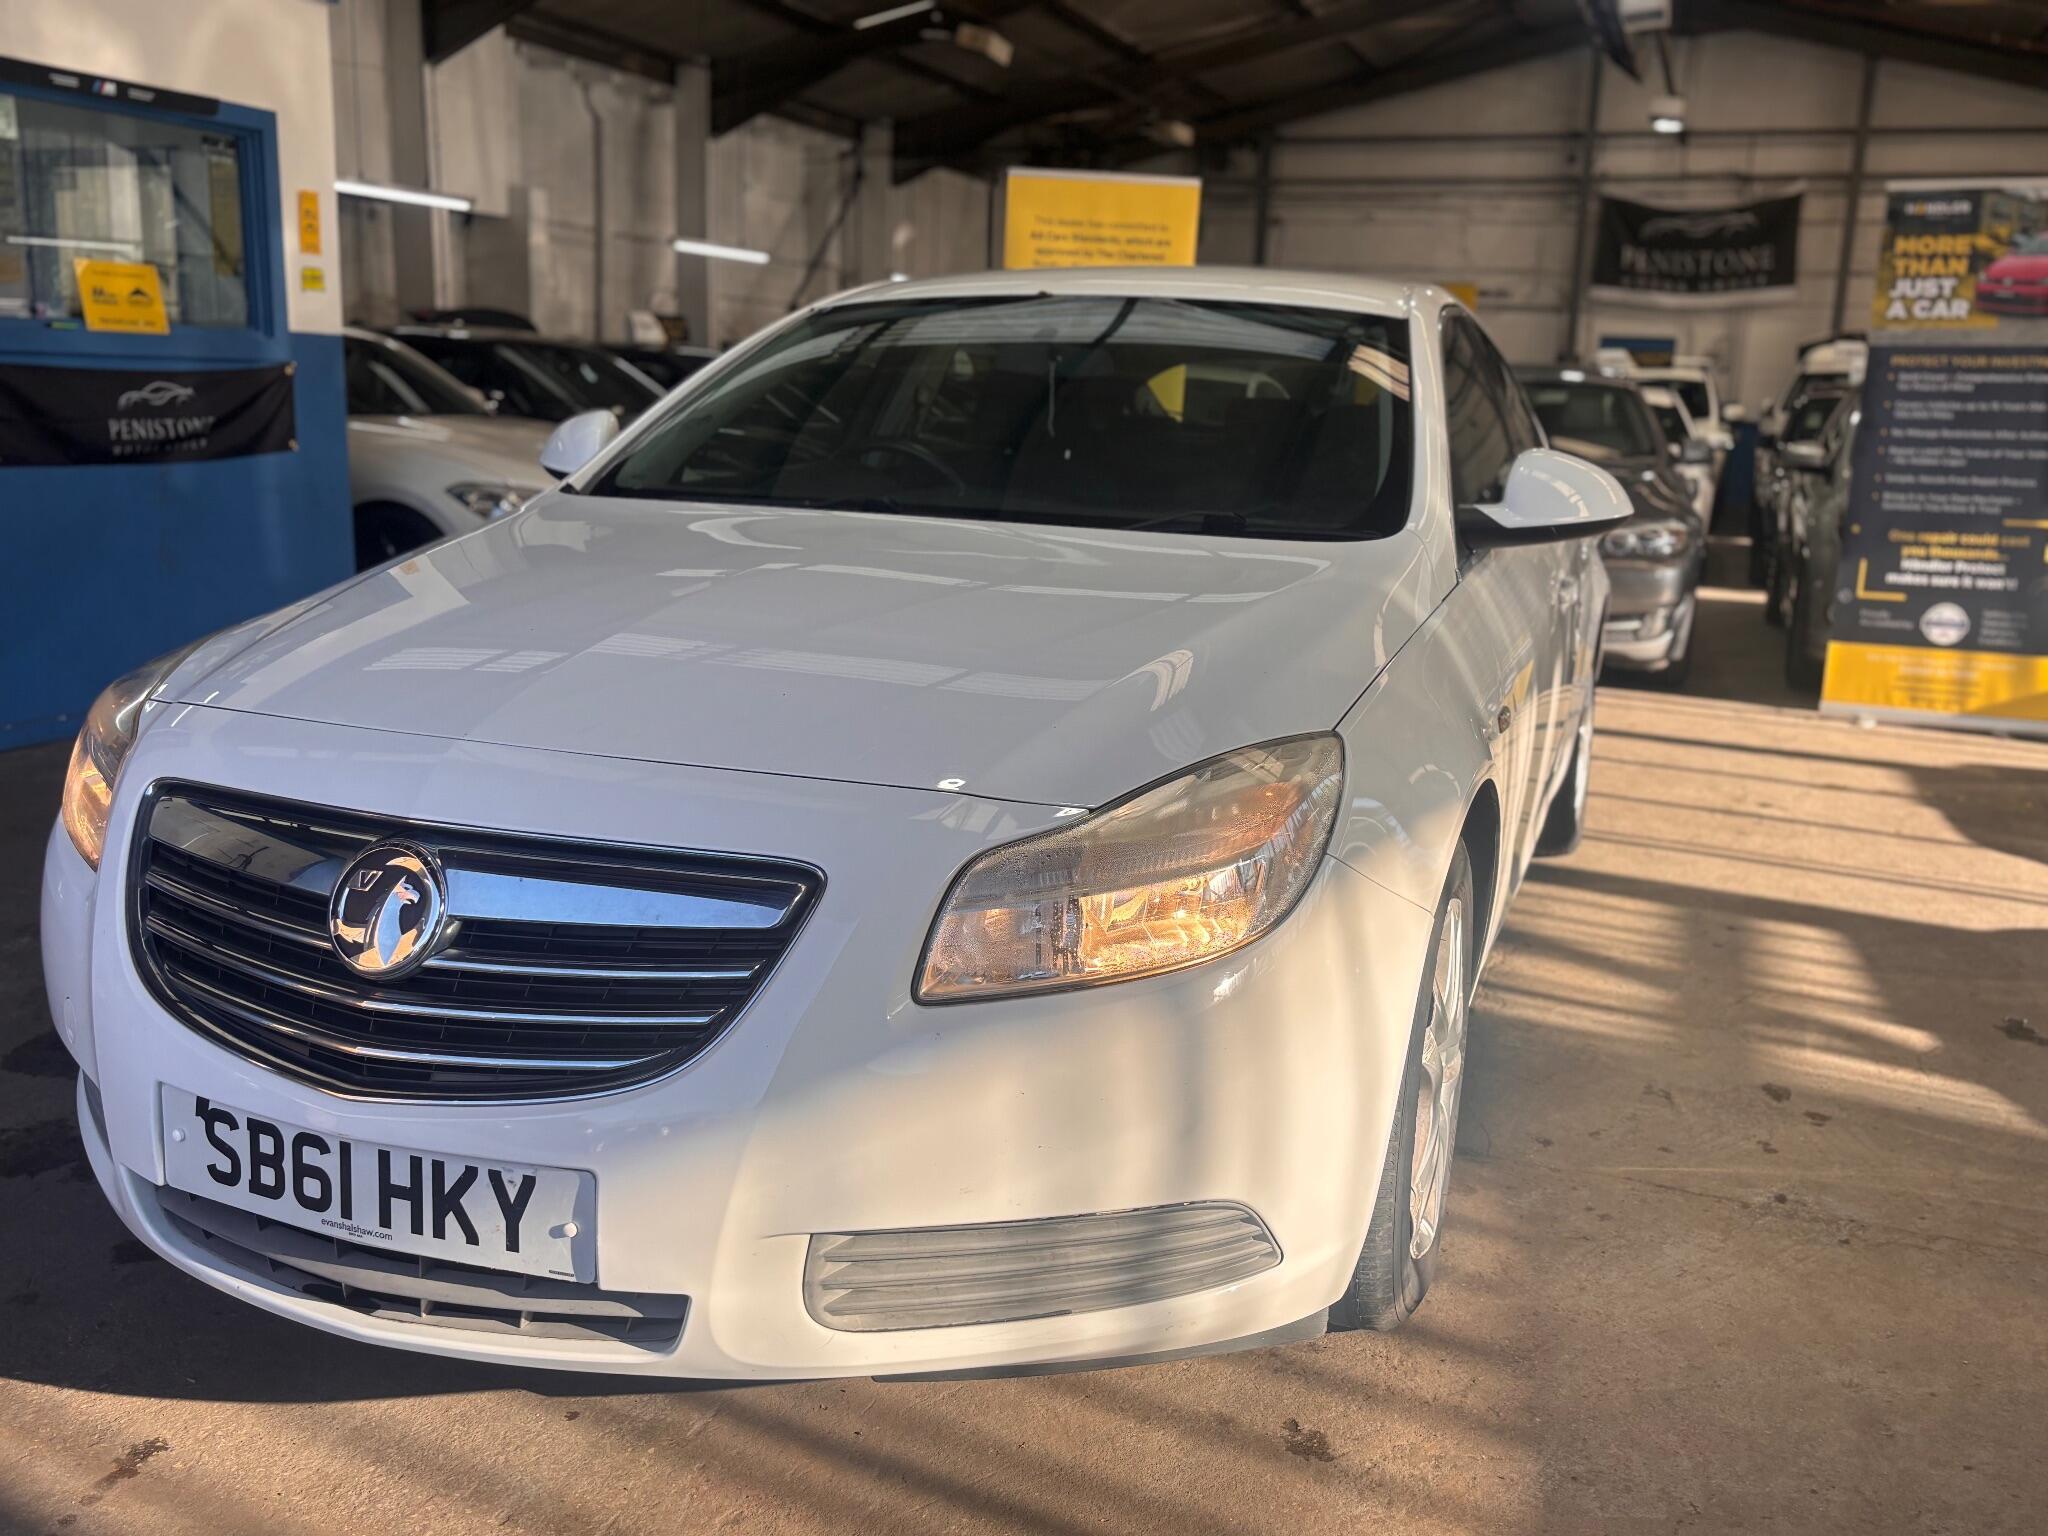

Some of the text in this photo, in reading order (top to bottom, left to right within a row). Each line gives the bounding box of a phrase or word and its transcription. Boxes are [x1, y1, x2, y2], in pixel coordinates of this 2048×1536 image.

[1894, 234, 1972, 255] MORE
[1620, 243, 1775, 276] PENISTONE
[1893, 256, 1969, 275] THAN
[1889, 277, 1957, 298] JUST
[1886, 298, 1970, 319] A CAR
[203, 1107, 537, 1253] SB61 HKY
[321, 1218, 393, 1241] evanshalshaw.com
